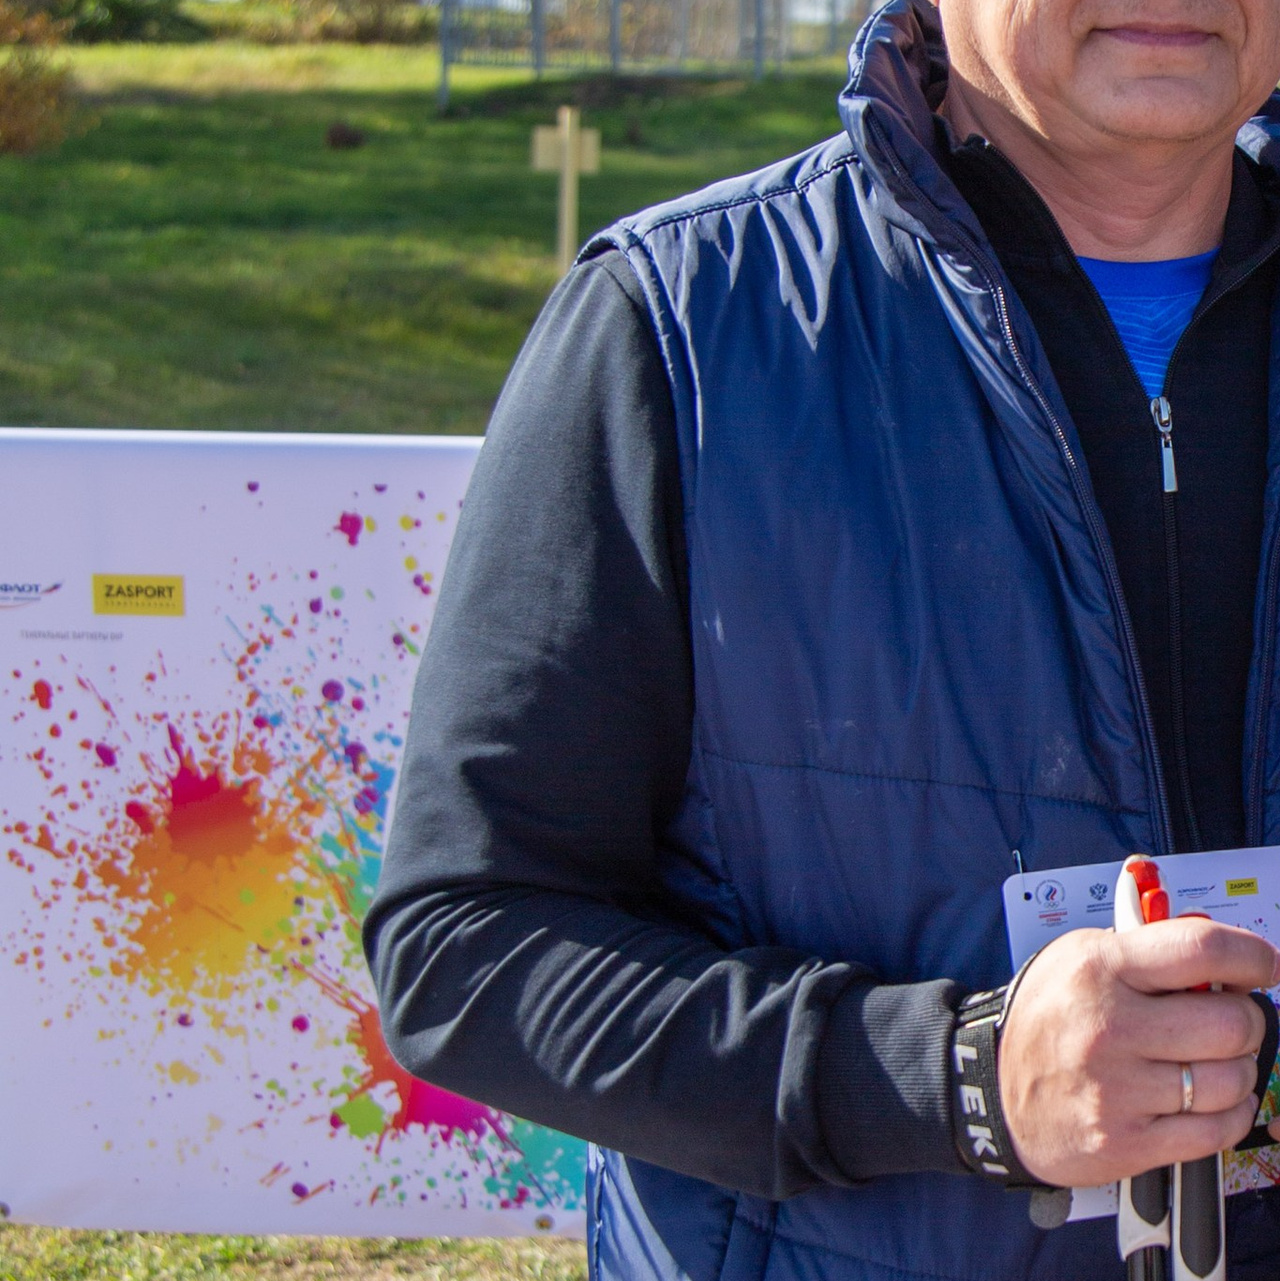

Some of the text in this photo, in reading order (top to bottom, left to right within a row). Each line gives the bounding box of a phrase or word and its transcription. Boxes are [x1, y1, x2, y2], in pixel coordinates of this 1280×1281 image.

[104, 583, 175, 599] ZASPORT
[1230, 881, 1255, 890] ZASPORT
[954, 1043, 1010, 1176] LEKI
